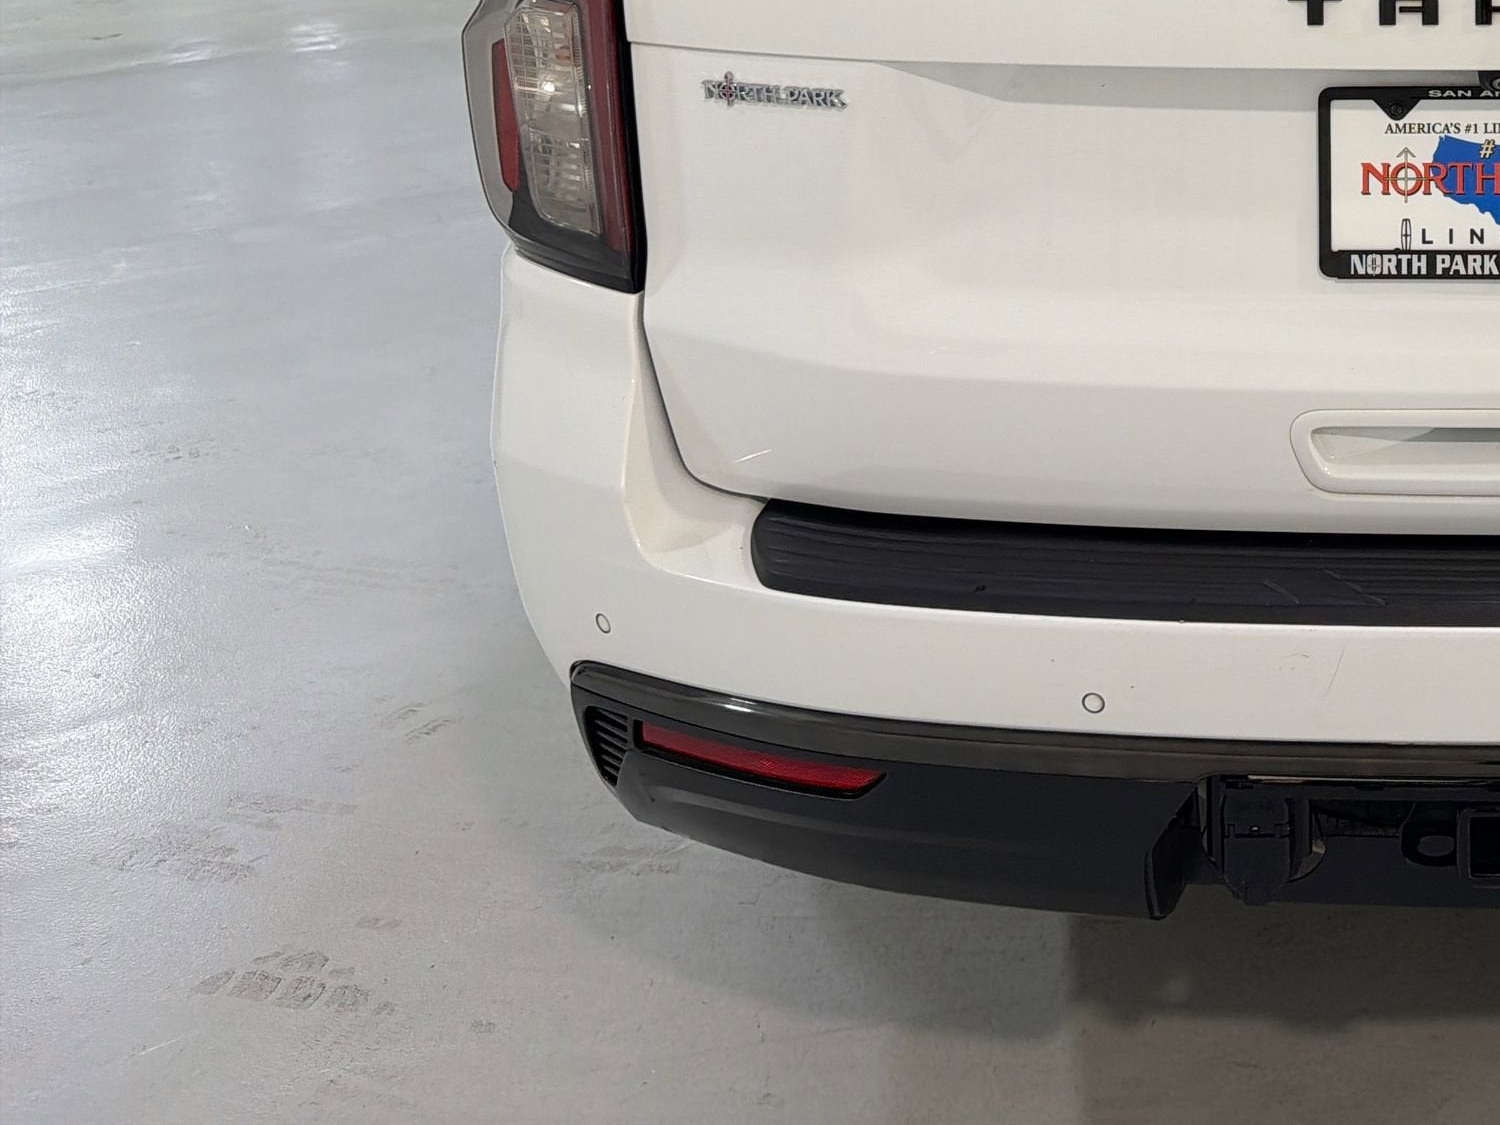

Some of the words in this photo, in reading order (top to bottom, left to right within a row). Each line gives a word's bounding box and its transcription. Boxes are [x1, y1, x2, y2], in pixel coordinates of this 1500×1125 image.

[701, 79, 781, 105] NORTH
[783, 85, 848, 109] PARK
[1428, 89, 1472, 98] SAN
[1384, 122, 1462, 135] AMERICA'S
[1464, 123, 1479, 135] #1
[1350, 254, 1428, 275] NORTH
[1436, 254, 1499, 275] PARK
